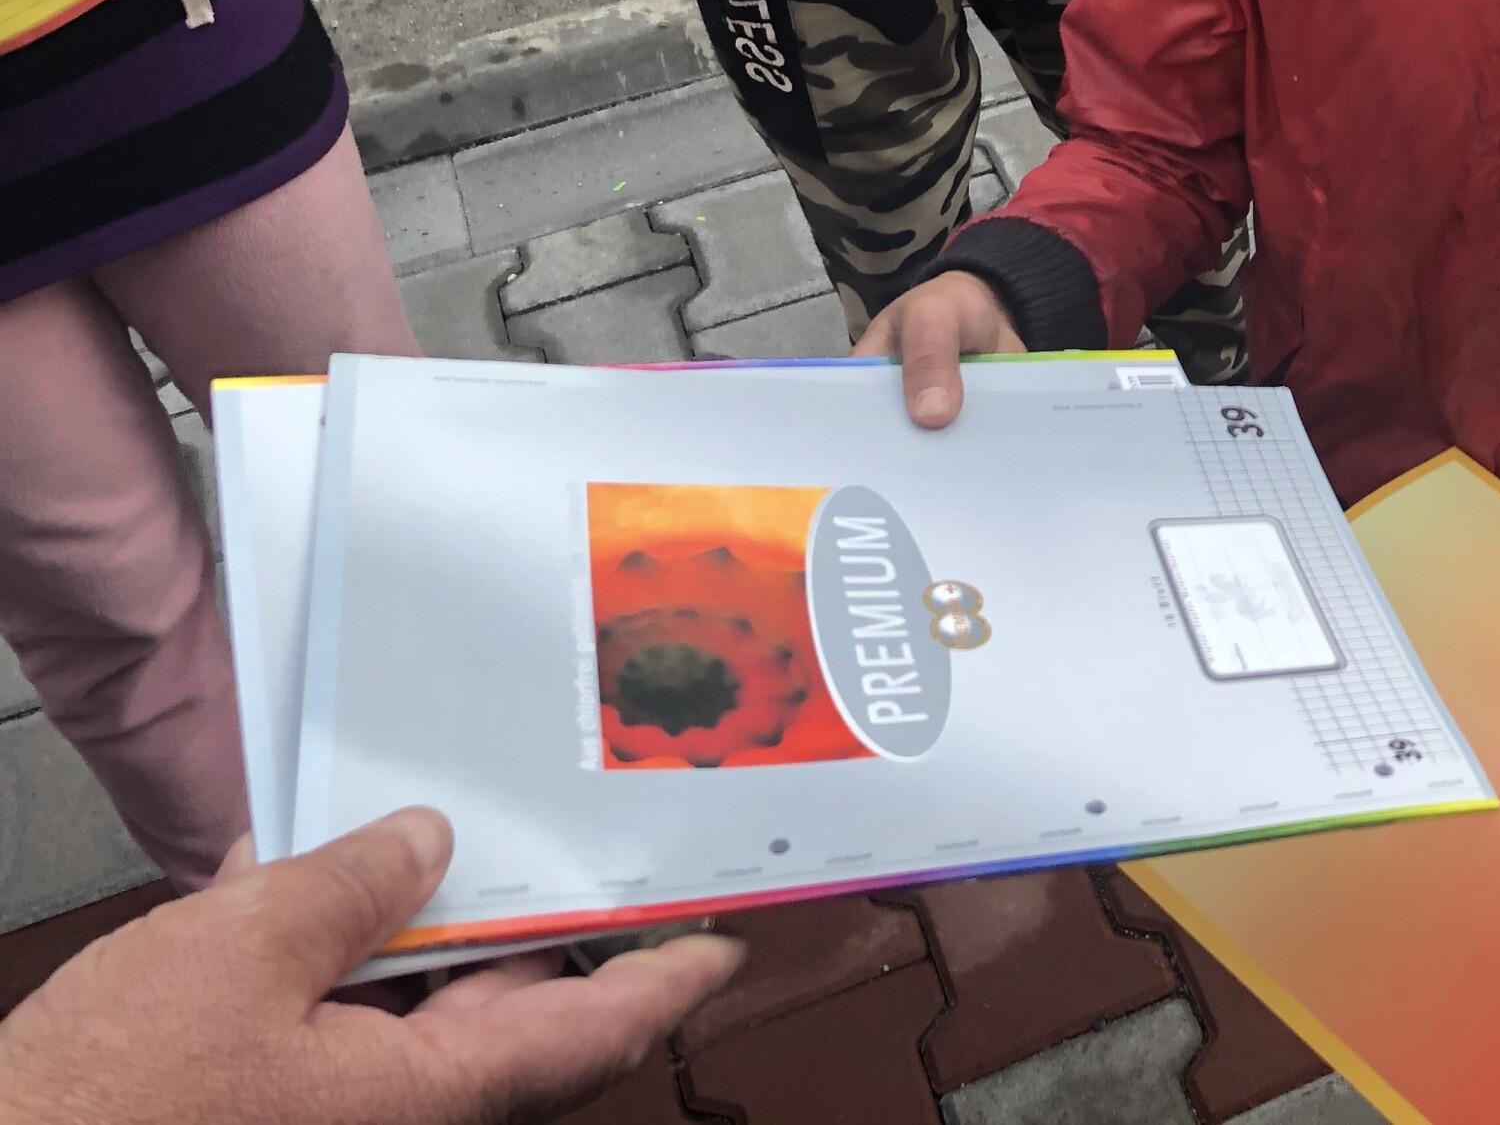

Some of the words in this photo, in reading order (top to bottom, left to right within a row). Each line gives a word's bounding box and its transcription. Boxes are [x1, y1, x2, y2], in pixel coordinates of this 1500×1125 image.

[1220, 406, 1265, 438] 39
[832, 516, 930, 725] PREMIUM
[1388, 738, 1422, 762] 39
